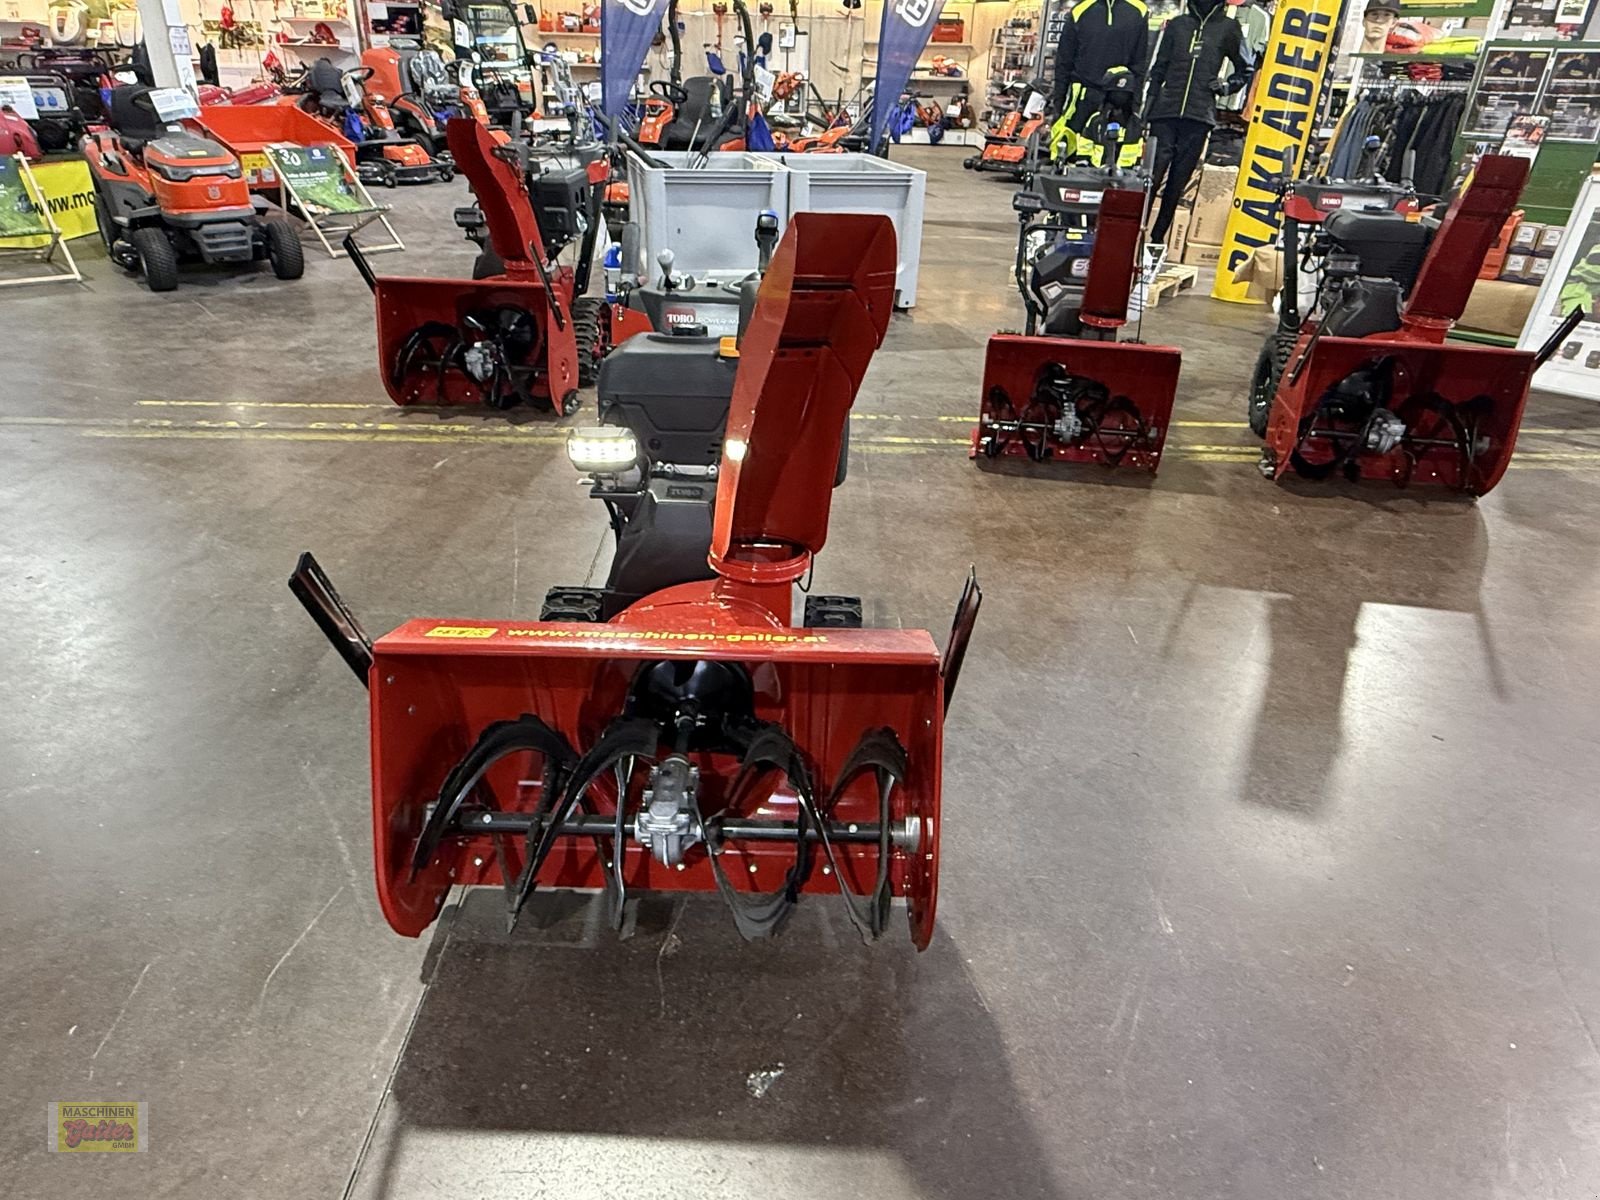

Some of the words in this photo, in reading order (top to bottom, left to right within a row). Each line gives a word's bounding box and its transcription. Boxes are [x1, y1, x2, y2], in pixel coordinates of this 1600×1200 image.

[1303, 45, 1340, 171] WORKWEAR
[1321, 197, 1342, 206] TORO
[666, 313, 695, 324] TORO
